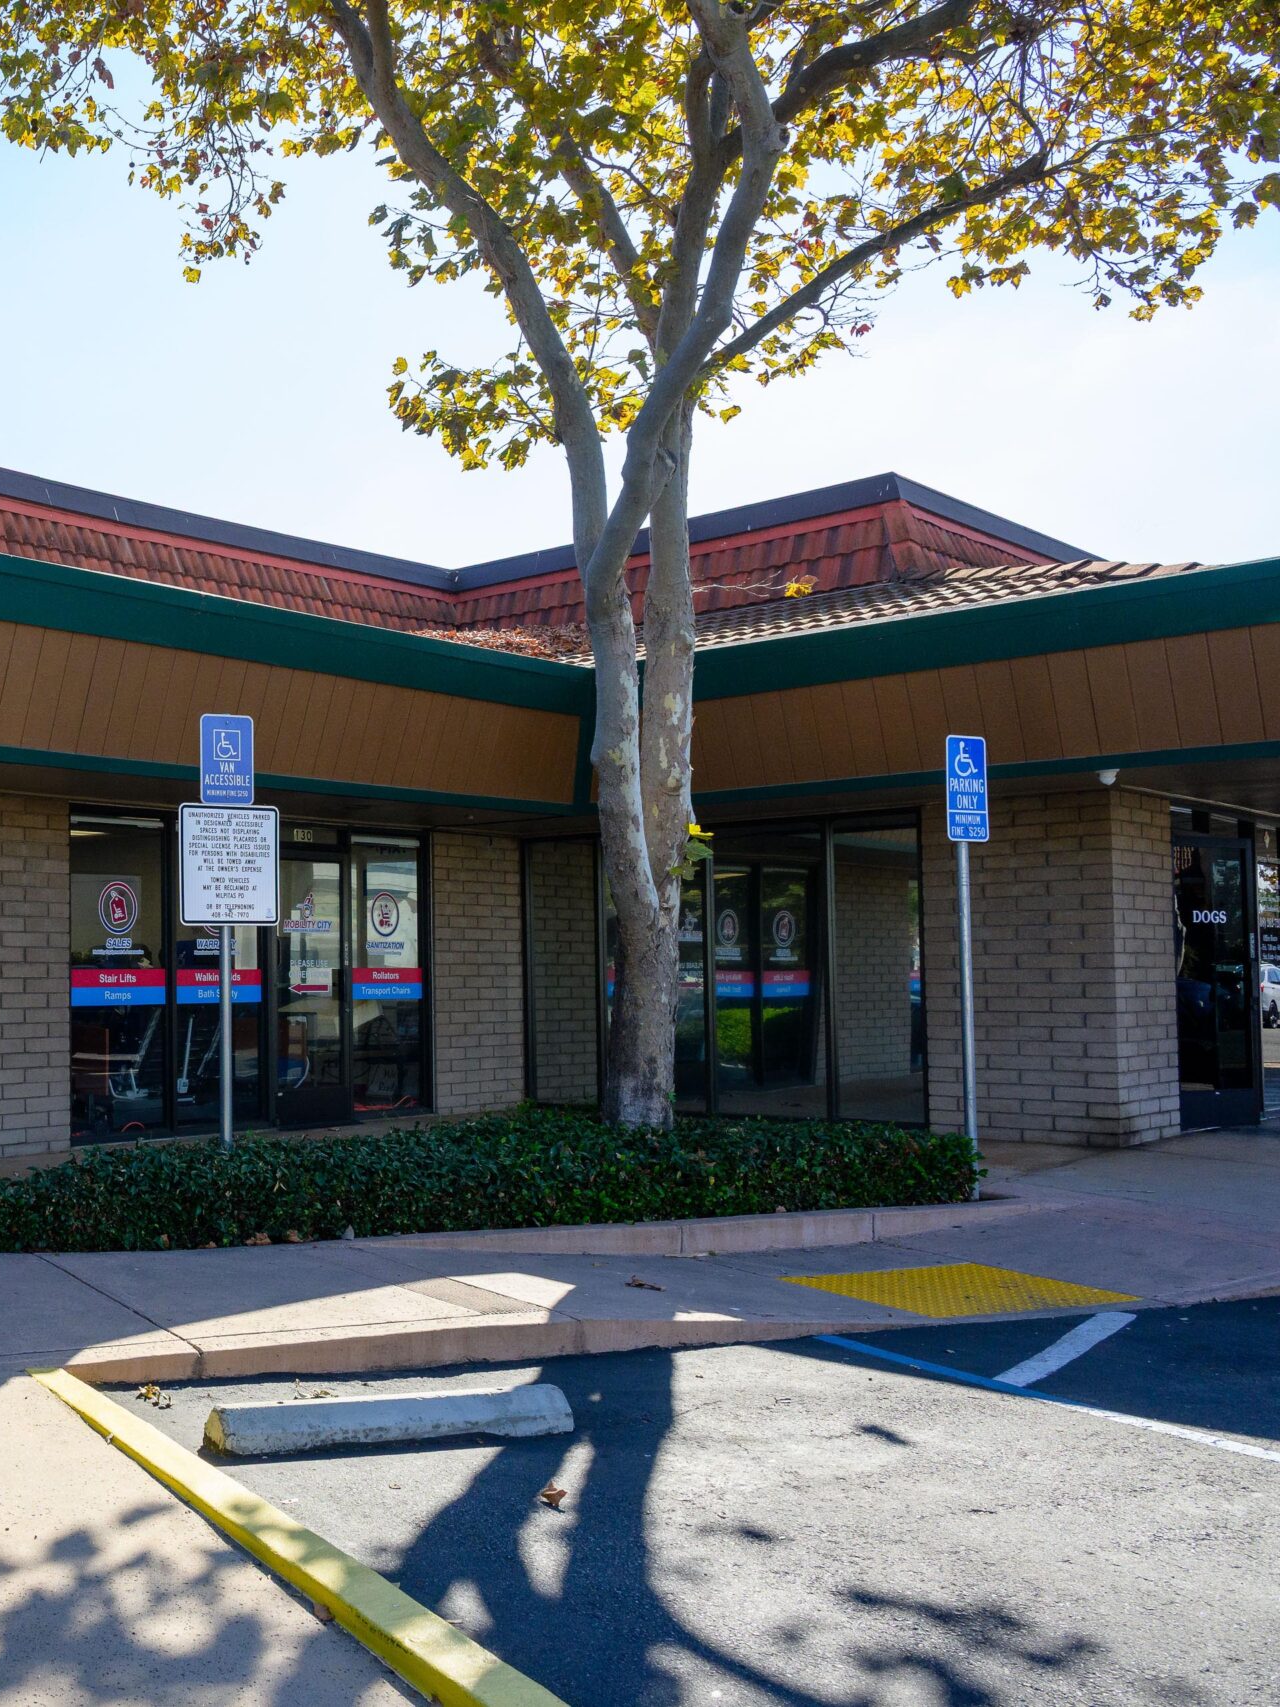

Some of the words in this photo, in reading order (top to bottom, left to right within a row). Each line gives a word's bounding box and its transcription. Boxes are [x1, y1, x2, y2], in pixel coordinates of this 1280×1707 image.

[219, 762, 235, 774] VAN
[205, 774, 250, 786] ACCESSIBLE
[949, 778, 984, 793] PARKING
[207, 789, 226, 797] MINIMUM
[956, 794, 978, 809] ONLY
[955, 814, 980, 825] MINIMUM
[295, 830, 312, 840] 130
[951, 826, 964, 836] FINE
[968, 826, 985, 837] $250
[1192, 910, 1227, 924] DOGS
[283, 920, 316, 928] MOBILITY
[317, 920, 332, 929] CITY
[106, 937, 133, 949] SALES
[366, 941, 404, 950] SANITIZATION
[290, 960, 314, 968] PLEASE
[316, 960, 328, 968] USE
[99, 973, 118, 983] Stair
[120, 973, 137, 983] Lifts
[195, 972, 219, 982] Walkin
[372, 972, 400, 980] Rollators
[104, 990, 132, 1001] Ramps
[198, 989, 214, 998] Bath
[361, 986, 390, 996] Transport
[392, 986, 411, 995] Chairs
